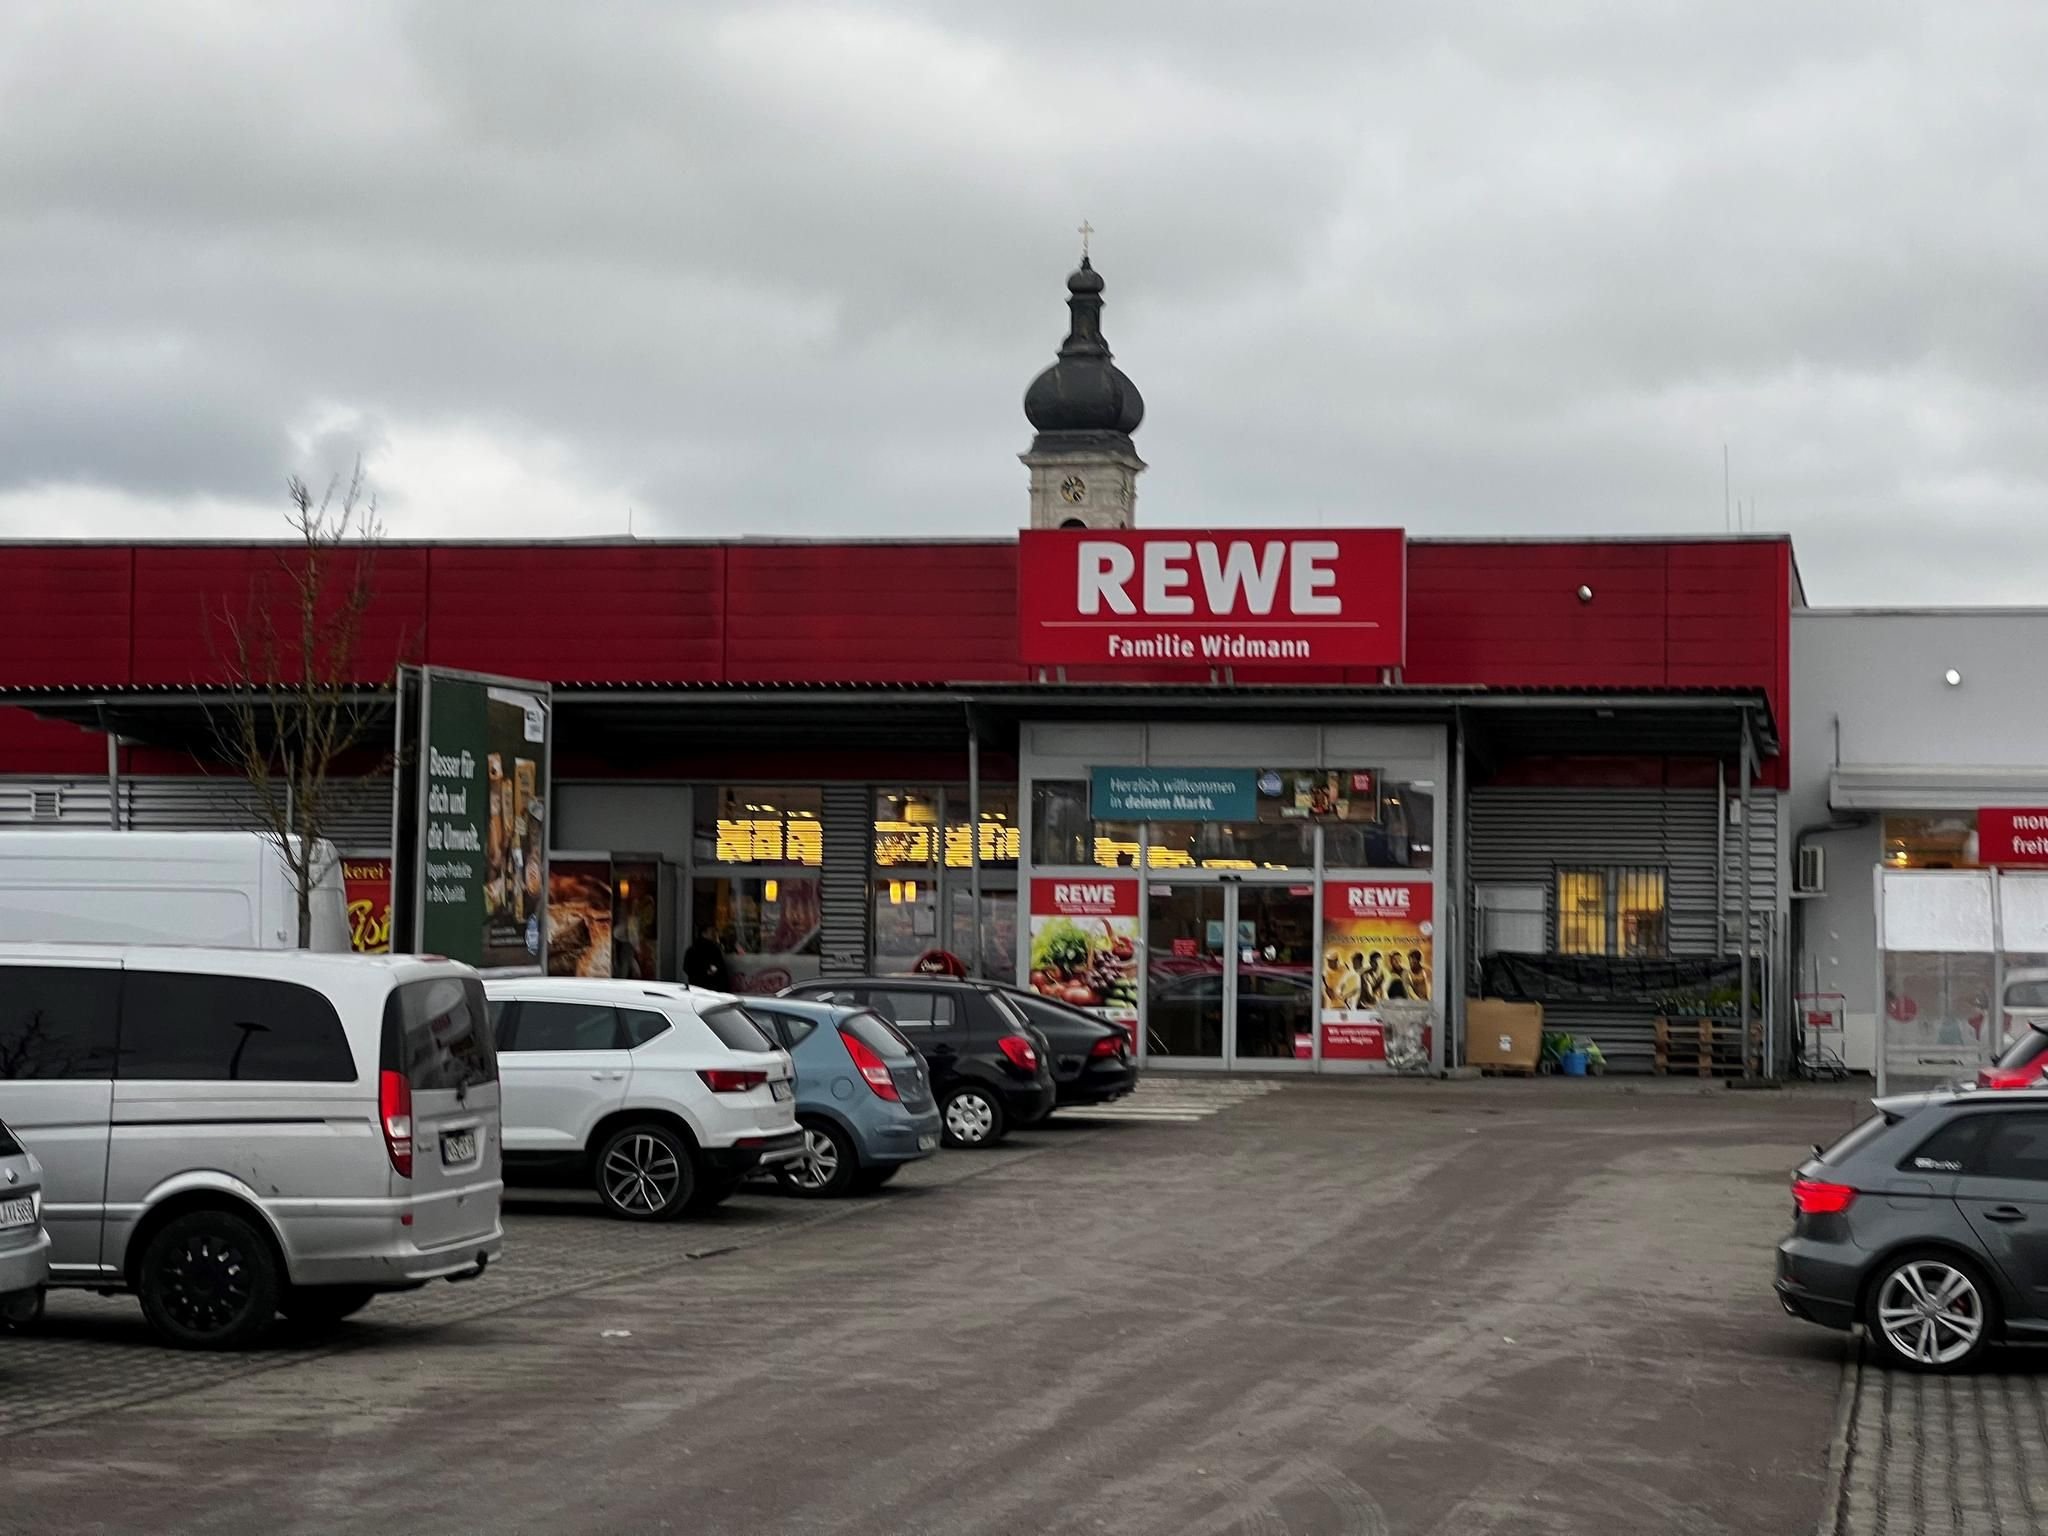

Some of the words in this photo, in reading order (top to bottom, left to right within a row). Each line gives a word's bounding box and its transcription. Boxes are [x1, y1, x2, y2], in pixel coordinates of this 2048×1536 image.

[1078, 540, 1342, 615] REWE
[1108, 633, 1195, 657] Familie
[1200, 633, 1311, 657] Widmann
[1110, 776, 1160, 793] Herzlich
[1163, 777, 1236, 794] willkommen
[1110, 793, 1122, 808] in
[1124, 793, 1171, 809] deinem
[1055, 884, 1116, 904] REWE
[1348, 887, 1410, 908] REWE
